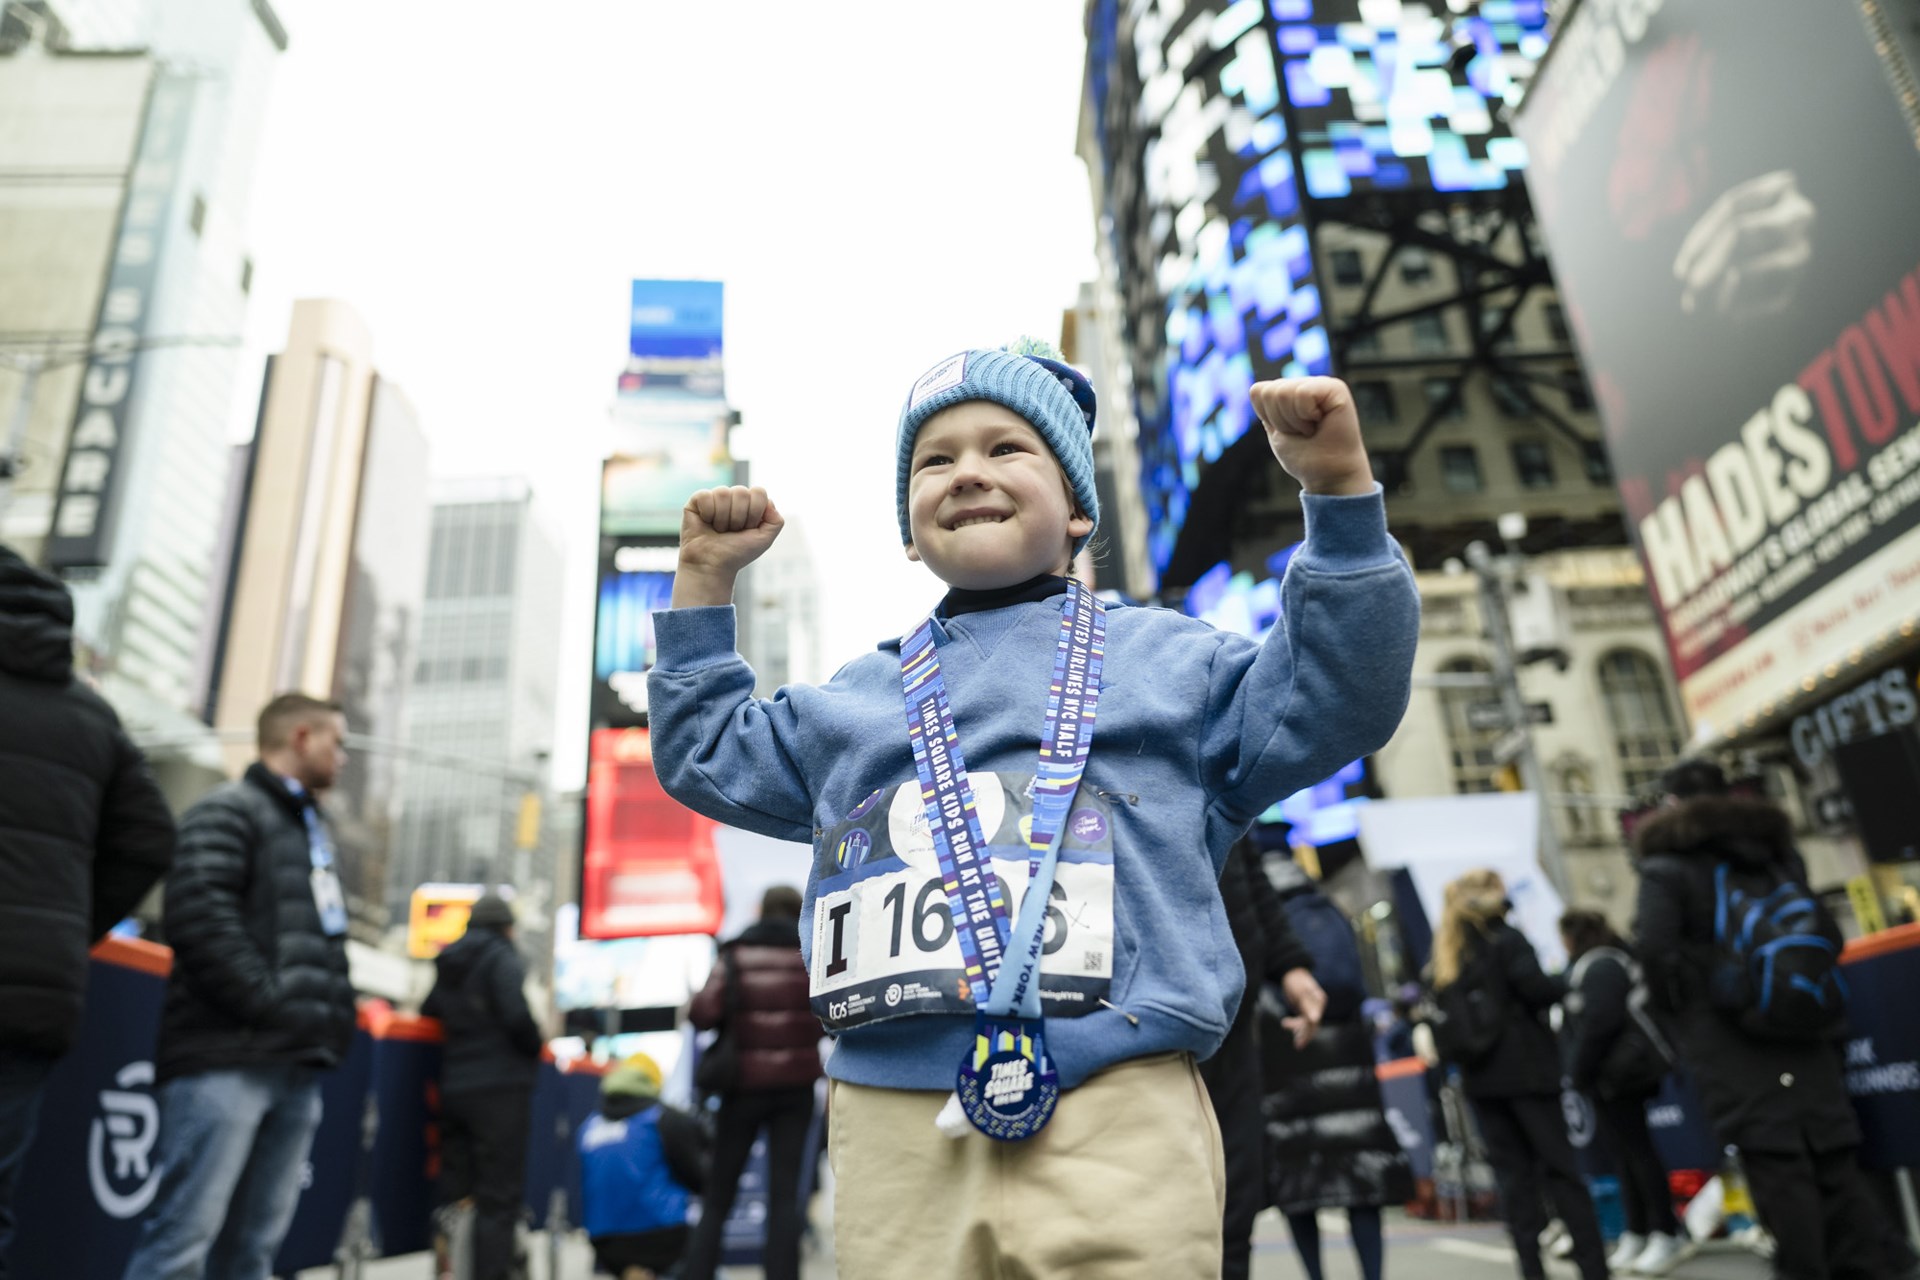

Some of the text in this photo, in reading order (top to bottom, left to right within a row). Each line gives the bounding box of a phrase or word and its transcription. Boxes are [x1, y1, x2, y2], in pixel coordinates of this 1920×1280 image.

[55, 286, 142, 537] SQUARE
[1639, 262, 1920, 607] HADESTOW
[1073, 608, 1092, 645] UNITED
[1065, 645, 1088, 697] AIRLINES
[1061, 697, 1081, 720] NYC
[1791, 668, 1917, 765] GIFTS
[1056, 722, 1077, 758] HALF
[921, 698, 1003, 988] TIMES SQUARE KIDS RUN AT THE UNITE
[883, 877, 1068, 957] 166
[826, 901, 852, 978] I
[1028, 923, 1045, 960] NEW
[1012, 964, 1034, 1006] YORK
[829, 1001, 848, 1020] tcs
[984, 1071, 1034, 1099] SQUARE
[991, 1058, 1028, 1081] TIMES
